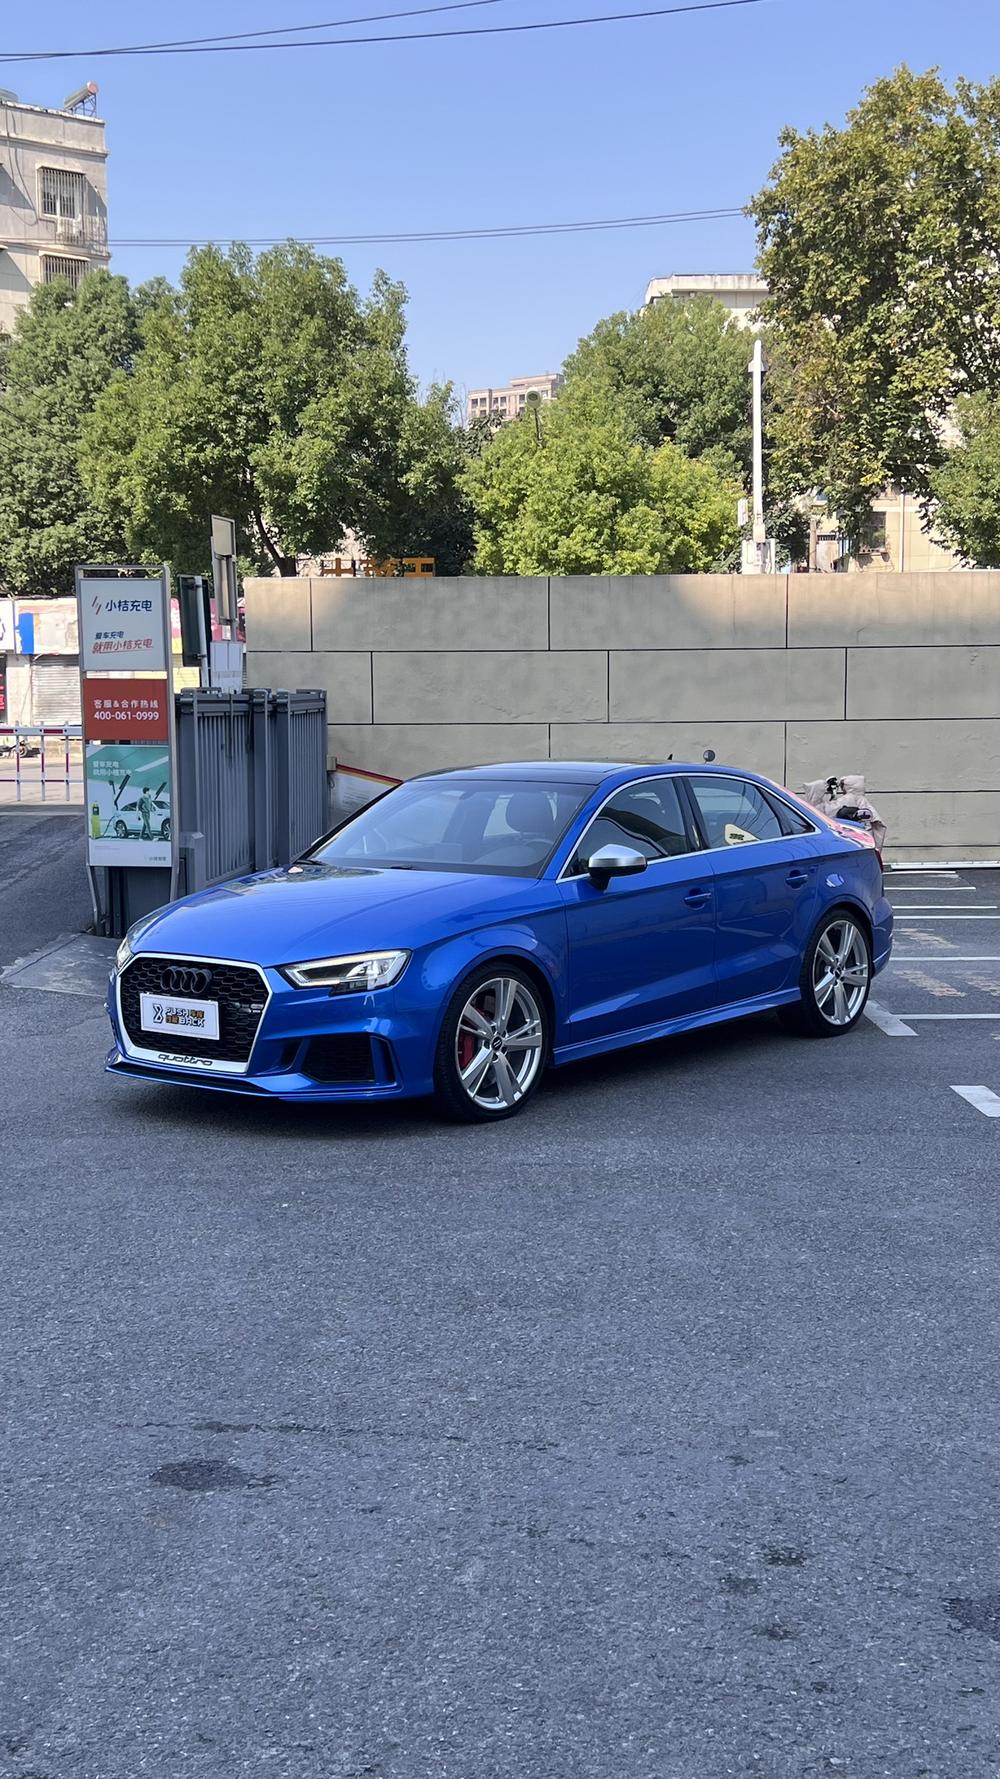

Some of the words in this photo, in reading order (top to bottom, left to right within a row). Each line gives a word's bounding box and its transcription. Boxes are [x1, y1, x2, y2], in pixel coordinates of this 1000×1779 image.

[105, 599, 153, 612] 小桔充电
[92, 638, 154, 654] 就用小桔充电
[93, 711, 159, 720] 400-061-0999
[165, 1007, 190, 1017] PUSH
[179, 1016, 205, 1027] BACK
[158, 1053, 213, 1066] quattro
